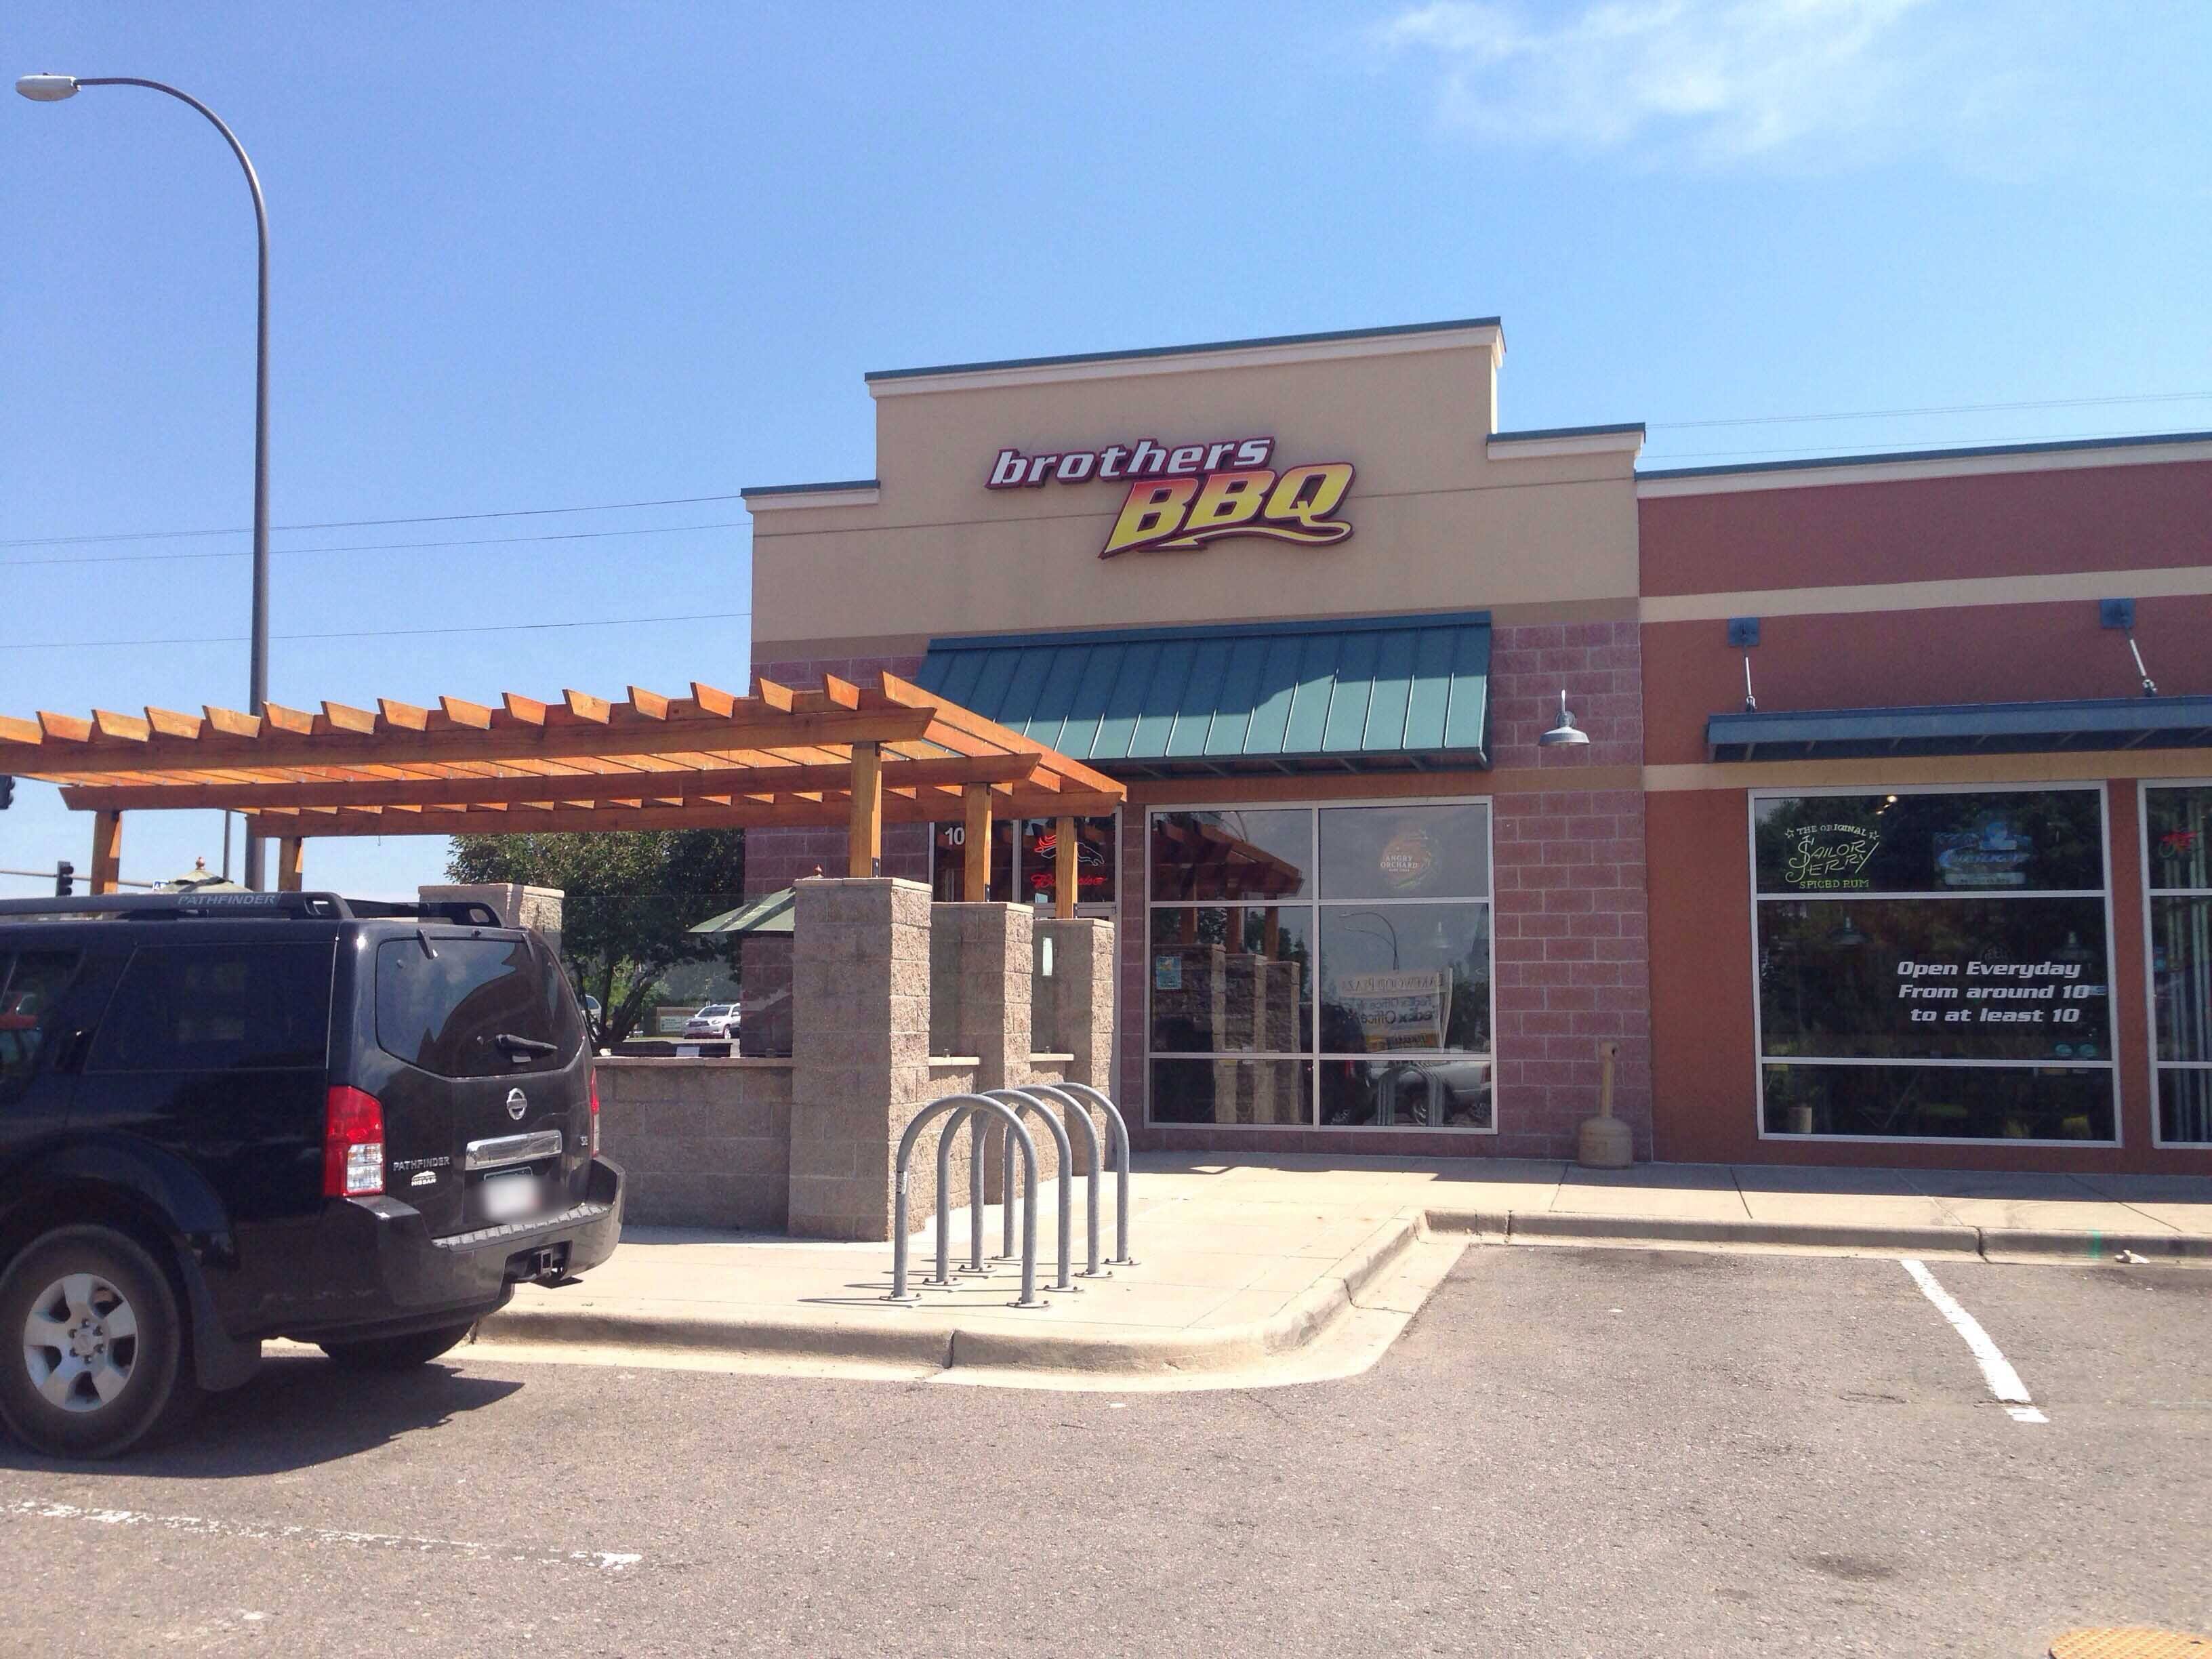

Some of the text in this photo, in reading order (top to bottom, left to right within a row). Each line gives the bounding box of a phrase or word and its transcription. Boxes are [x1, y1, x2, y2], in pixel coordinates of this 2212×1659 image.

[985, 436, 1274, 489] brothers
[1098, 462, 1355, 558] BBQ
[1797, 823, 1866, 836] THE ORIGINAL
[1799, 880, 1869, 889] SPICED RUM
[178, 895, 276, 905] PATHFINDER
[1898, 961, 2081, 979] Open Everyday
[1898, 984, 1959, 998] From
[1966, 985, 2055, 998] around
[2062, 985, 2090, 999] 10
[1910, 1008, 2080, 1023] to at least 10
[393, 1156, 450, 1171] PATHFINDER
[411, 1178, 436, 1187] NISSAN
